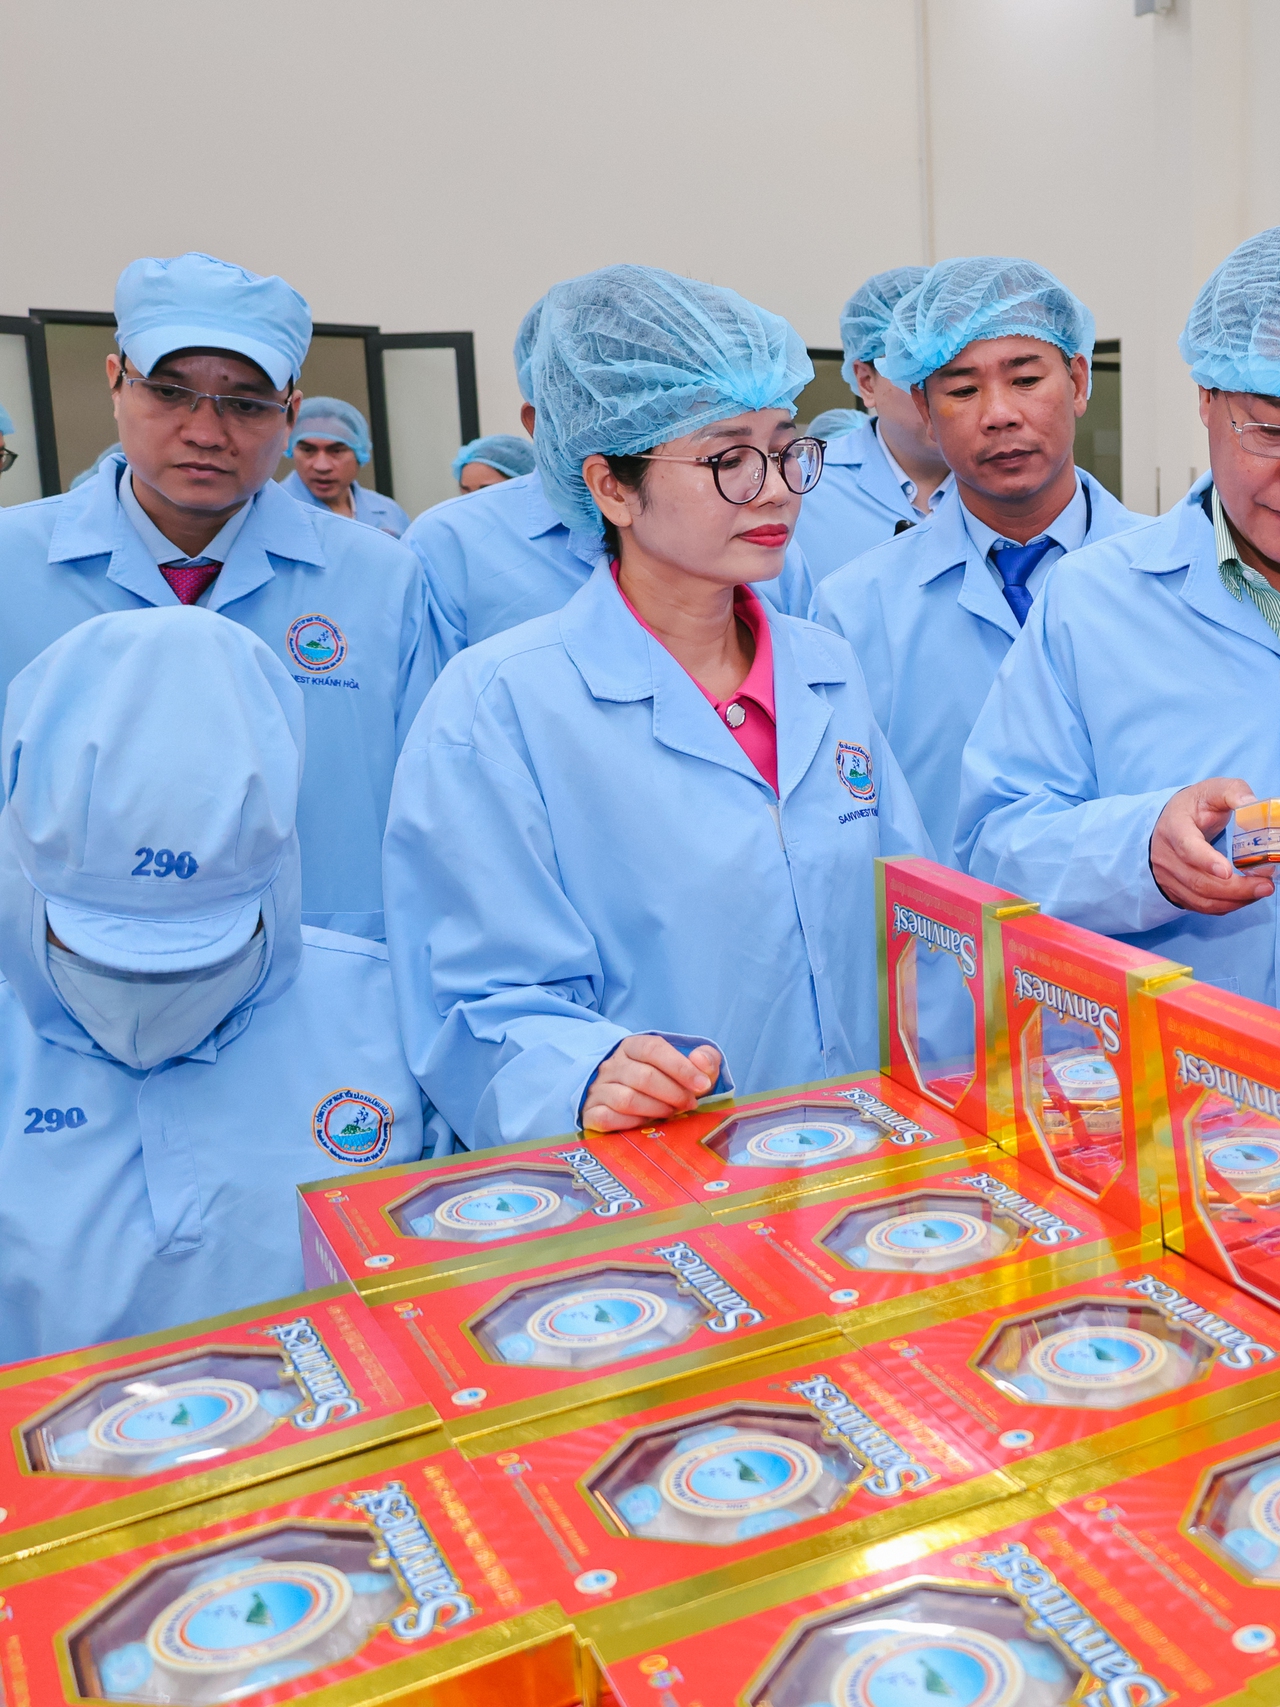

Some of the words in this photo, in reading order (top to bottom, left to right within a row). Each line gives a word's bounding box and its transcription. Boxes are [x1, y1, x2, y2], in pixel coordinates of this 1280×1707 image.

[311, 676, 341, 687] KHÁNH
[343, 678, 360, 690] HÒA
[838, 808, 870, 824] SANVINEST
[131, 847, 199, 879] 290
[893, 902, 977, 978] Sanvinest
[1014, 967, 1121, 1055] Sanvinest
[24, 1107, 88, 1134] 290
[842, 1087, 936, 1145] Sanvinest
[562, 1147, 643, 1217] Sanvinest
[965, 1171, 1084, 1245] Sanvinest
[655, 1241, 766, 1334] Sanvinest
[1121, 1274, 1277, 1372] Sanvinest
[792, 1372, 938, 1499] Sanvinest
[976, 1543, 1172, 1707] Sanvinest
